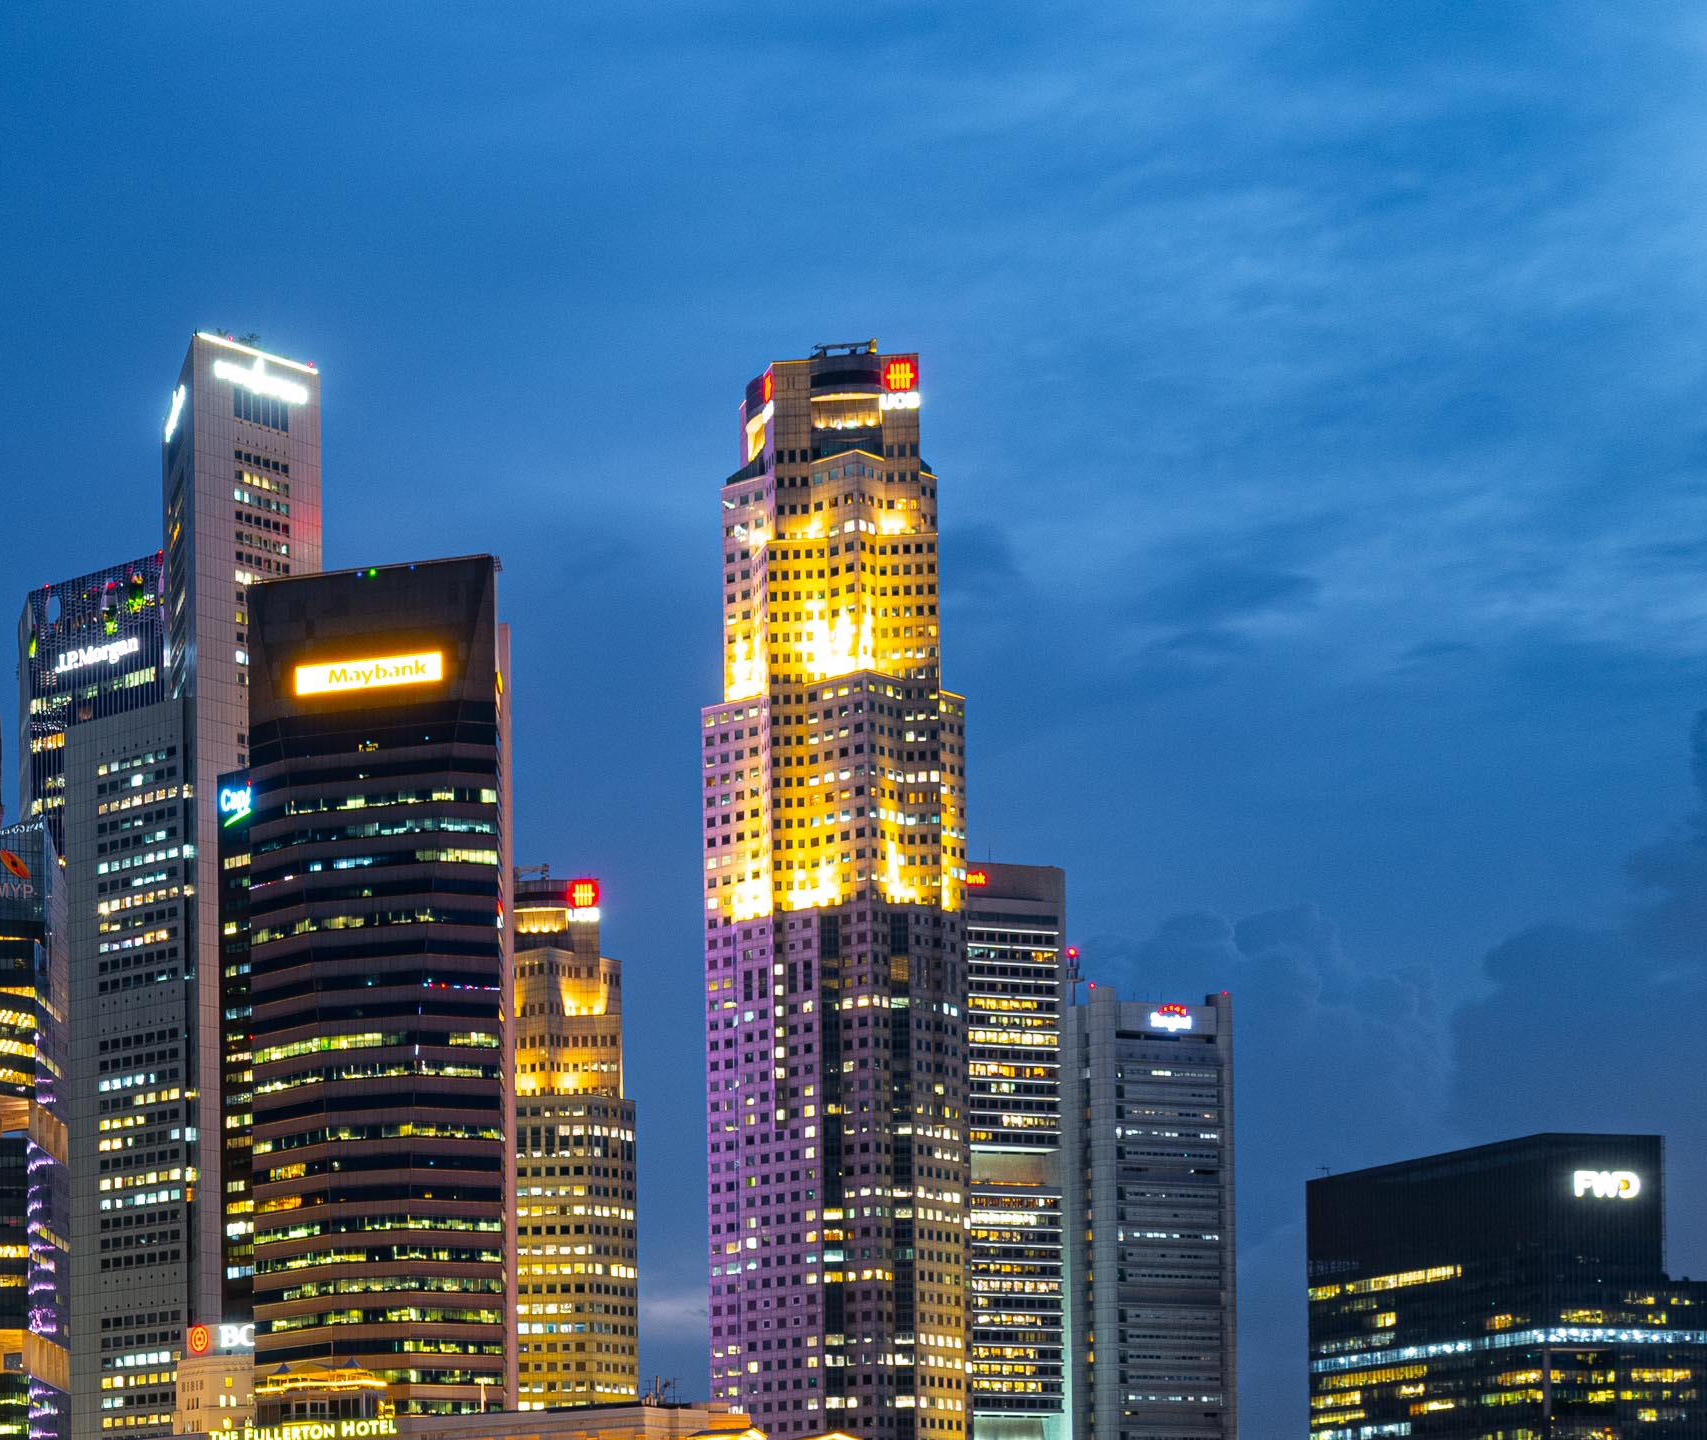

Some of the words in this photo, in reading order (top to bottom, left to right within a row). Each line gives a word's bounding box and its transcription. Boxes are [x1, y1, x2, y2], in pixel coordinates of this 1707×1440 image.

[328, 658, 427, 685] Maybank
[966, 871, 986, 885] ank
[1573, 1170, 1641, 1199] FWD
[341, 1418, 397, 1438] HOTEL
